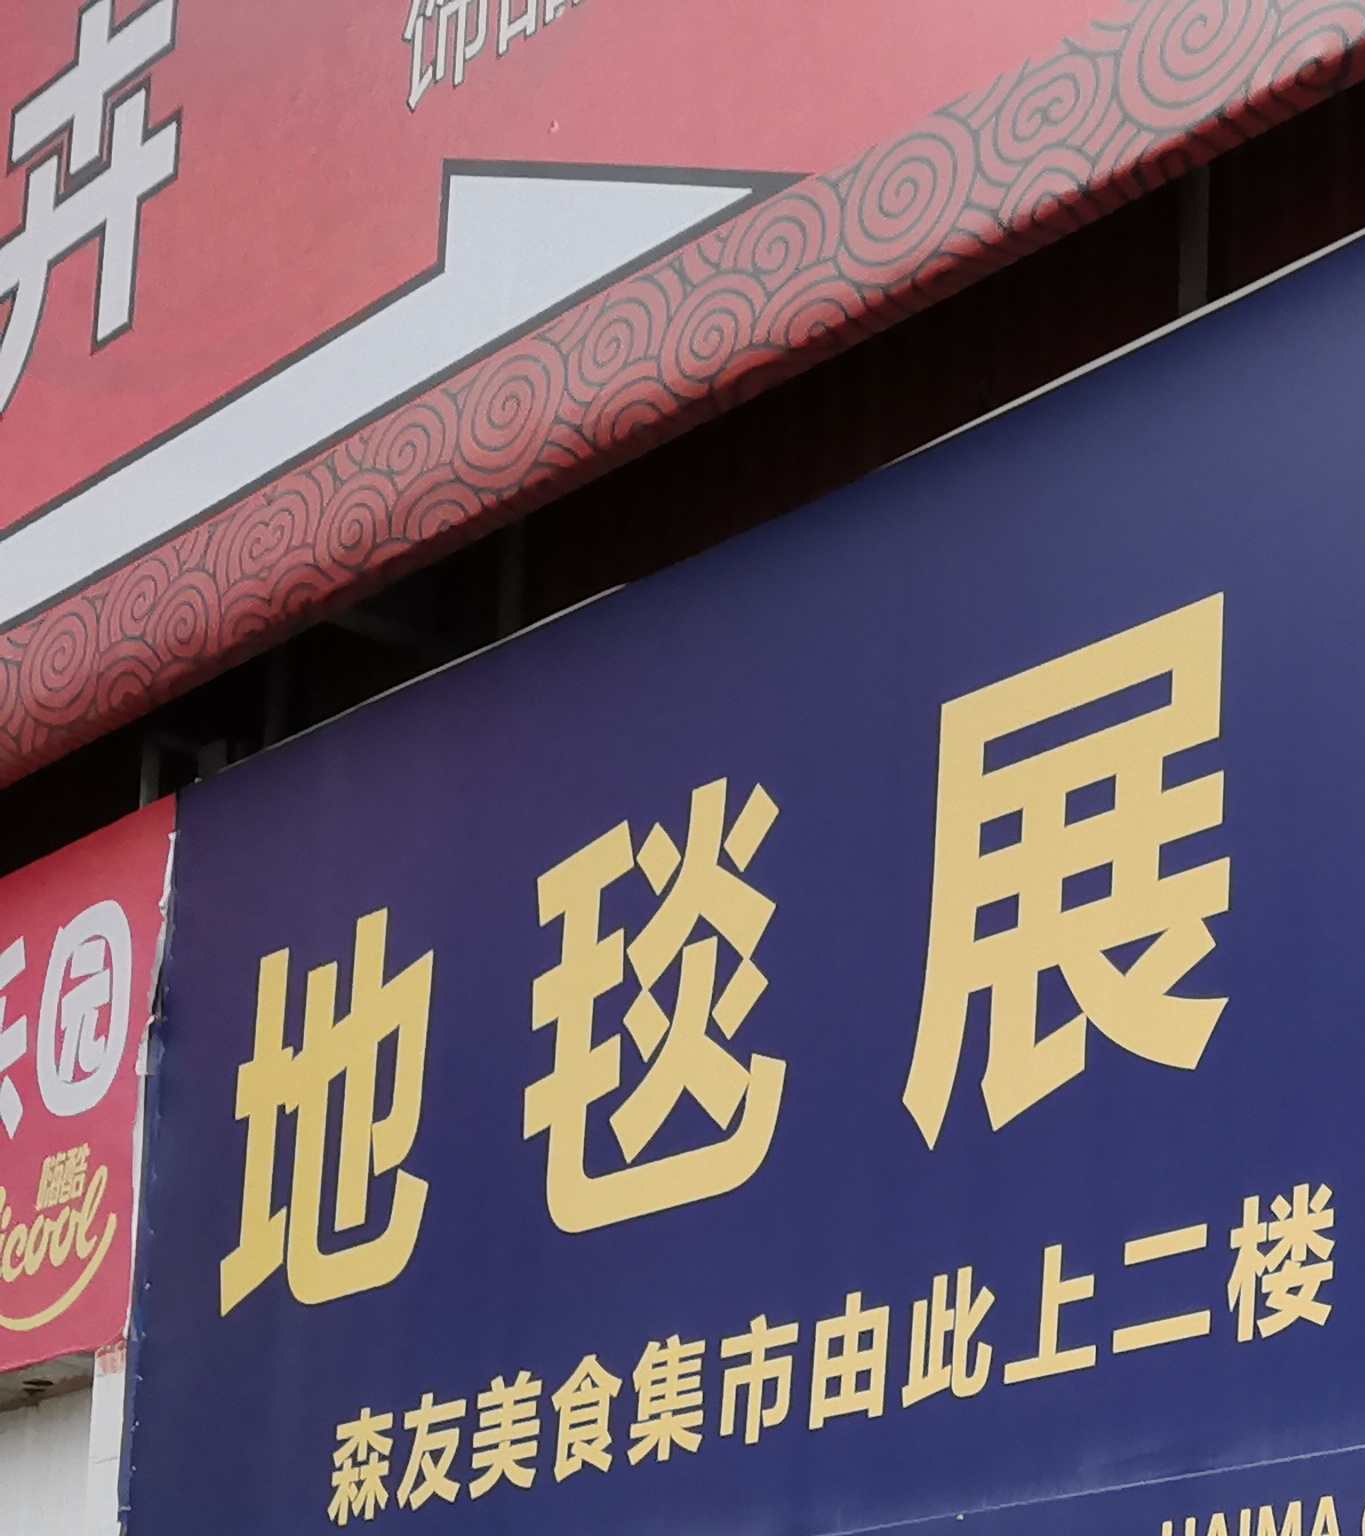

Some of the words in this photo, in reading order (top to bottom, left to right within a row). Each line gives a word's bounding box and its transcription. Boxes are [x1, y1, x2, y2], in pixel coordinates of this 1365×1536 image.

[328, 1182, 1337, 1527] 森友美食集市由此上二楼
